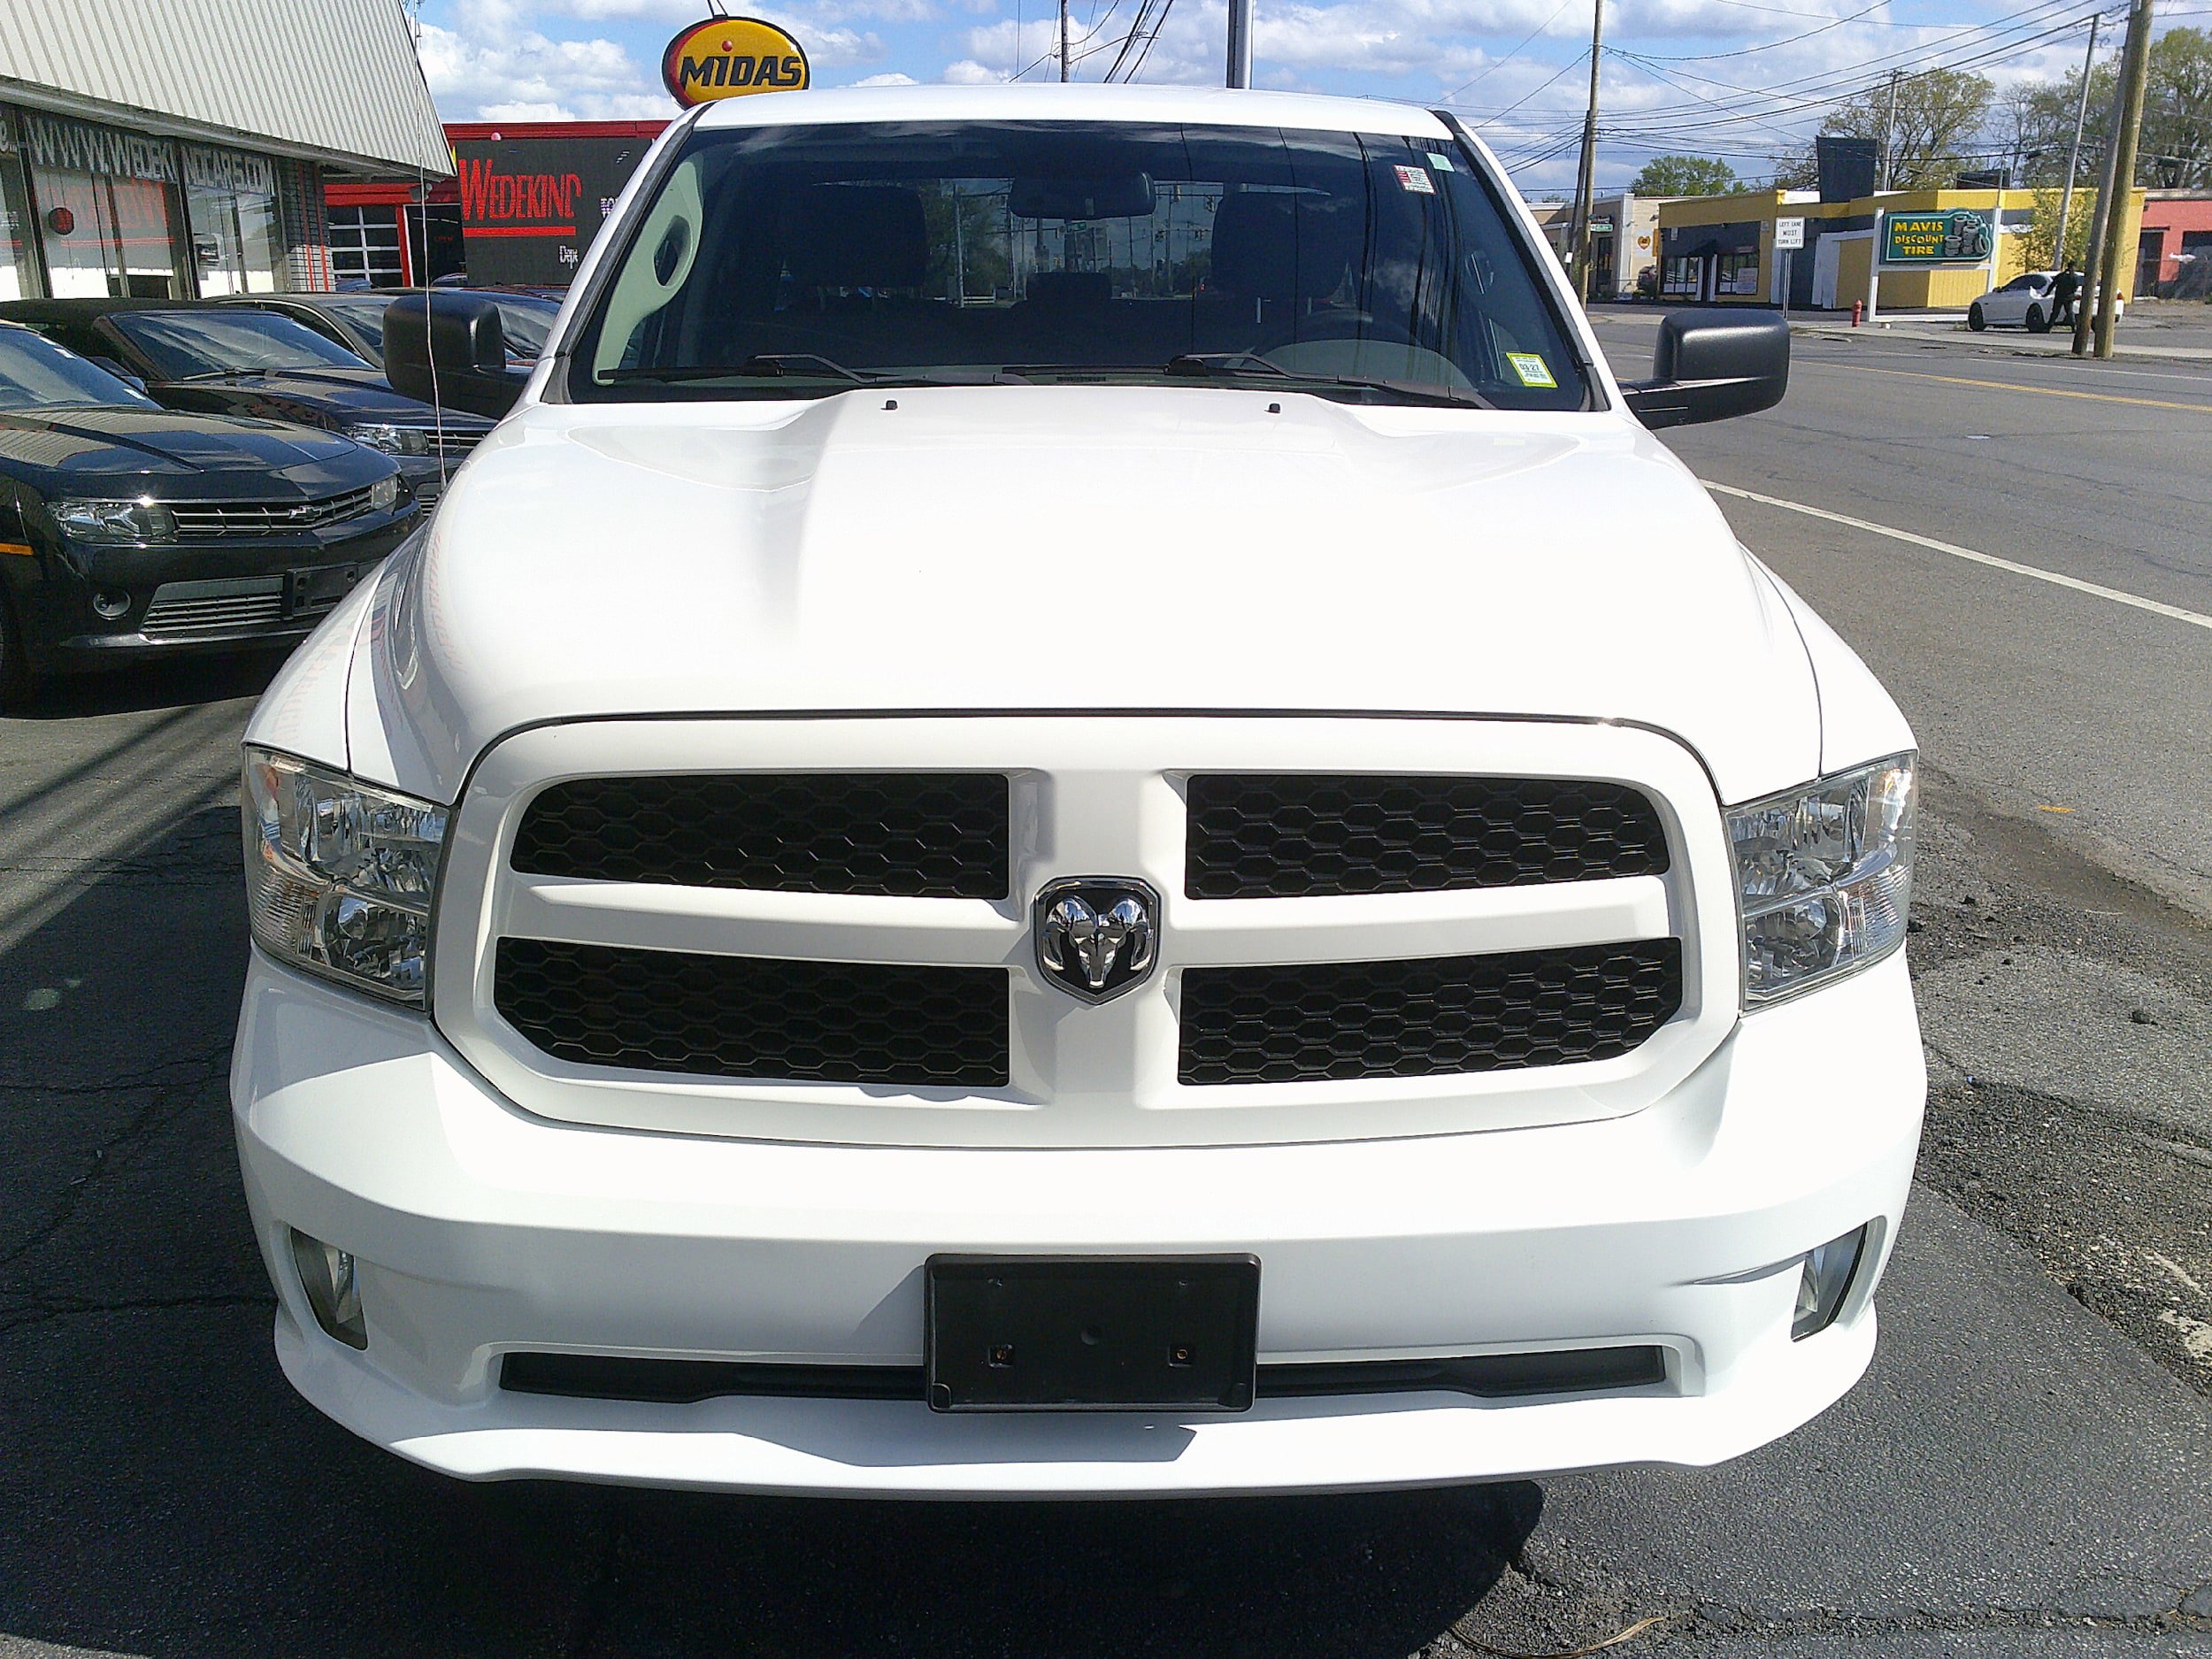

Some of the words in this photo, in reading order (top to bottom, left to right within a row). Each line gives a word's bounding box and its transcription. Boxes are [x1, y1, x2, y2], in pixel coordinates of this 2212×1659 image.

[680, 56, 803, 91] MIDAS
[1894, 221, 1943, 232] MAVIS
[1894, 234, 1945, 244] DISCOUNT
[1902, 245, 1935, 255] TIRE
